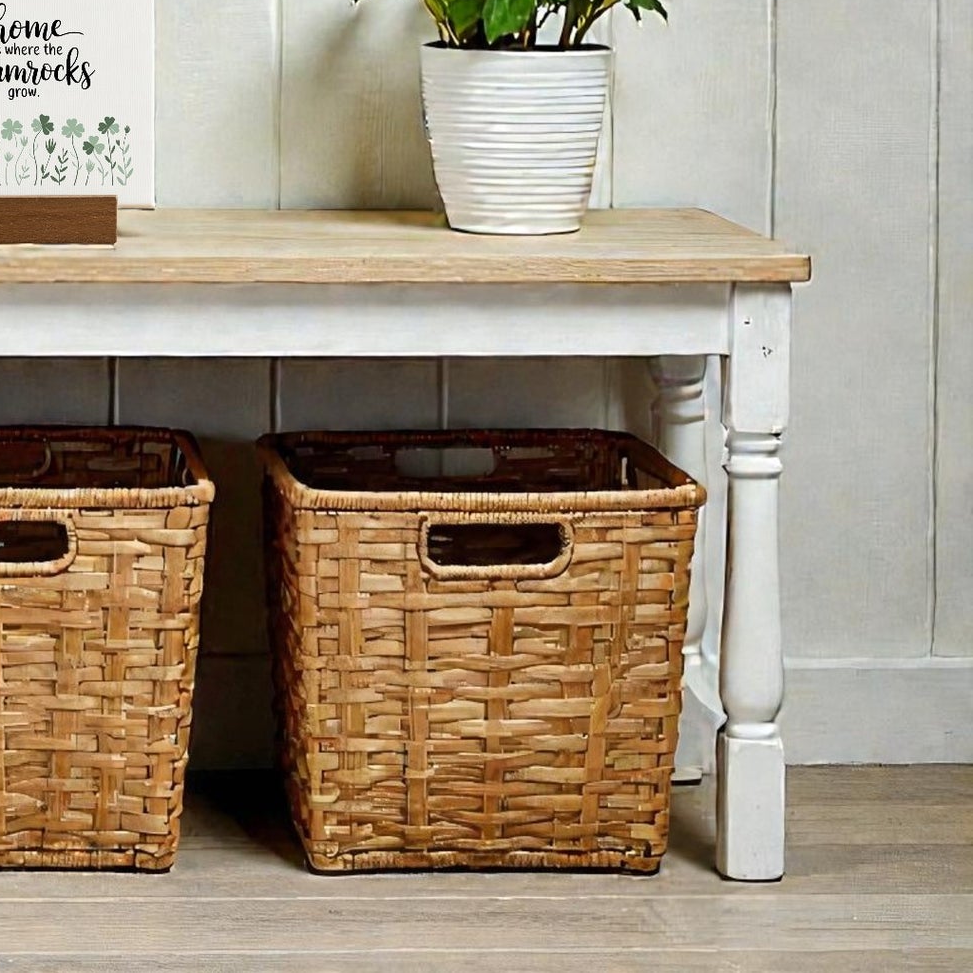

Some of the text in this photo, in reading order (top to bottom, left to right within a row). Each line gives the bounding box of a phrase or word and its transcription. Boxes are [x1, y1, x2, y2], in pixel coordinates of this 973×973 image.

[4, 43, 40, 56] where
[44, 43, 63, 56] the
[8, 87, 40, 100] grow.
